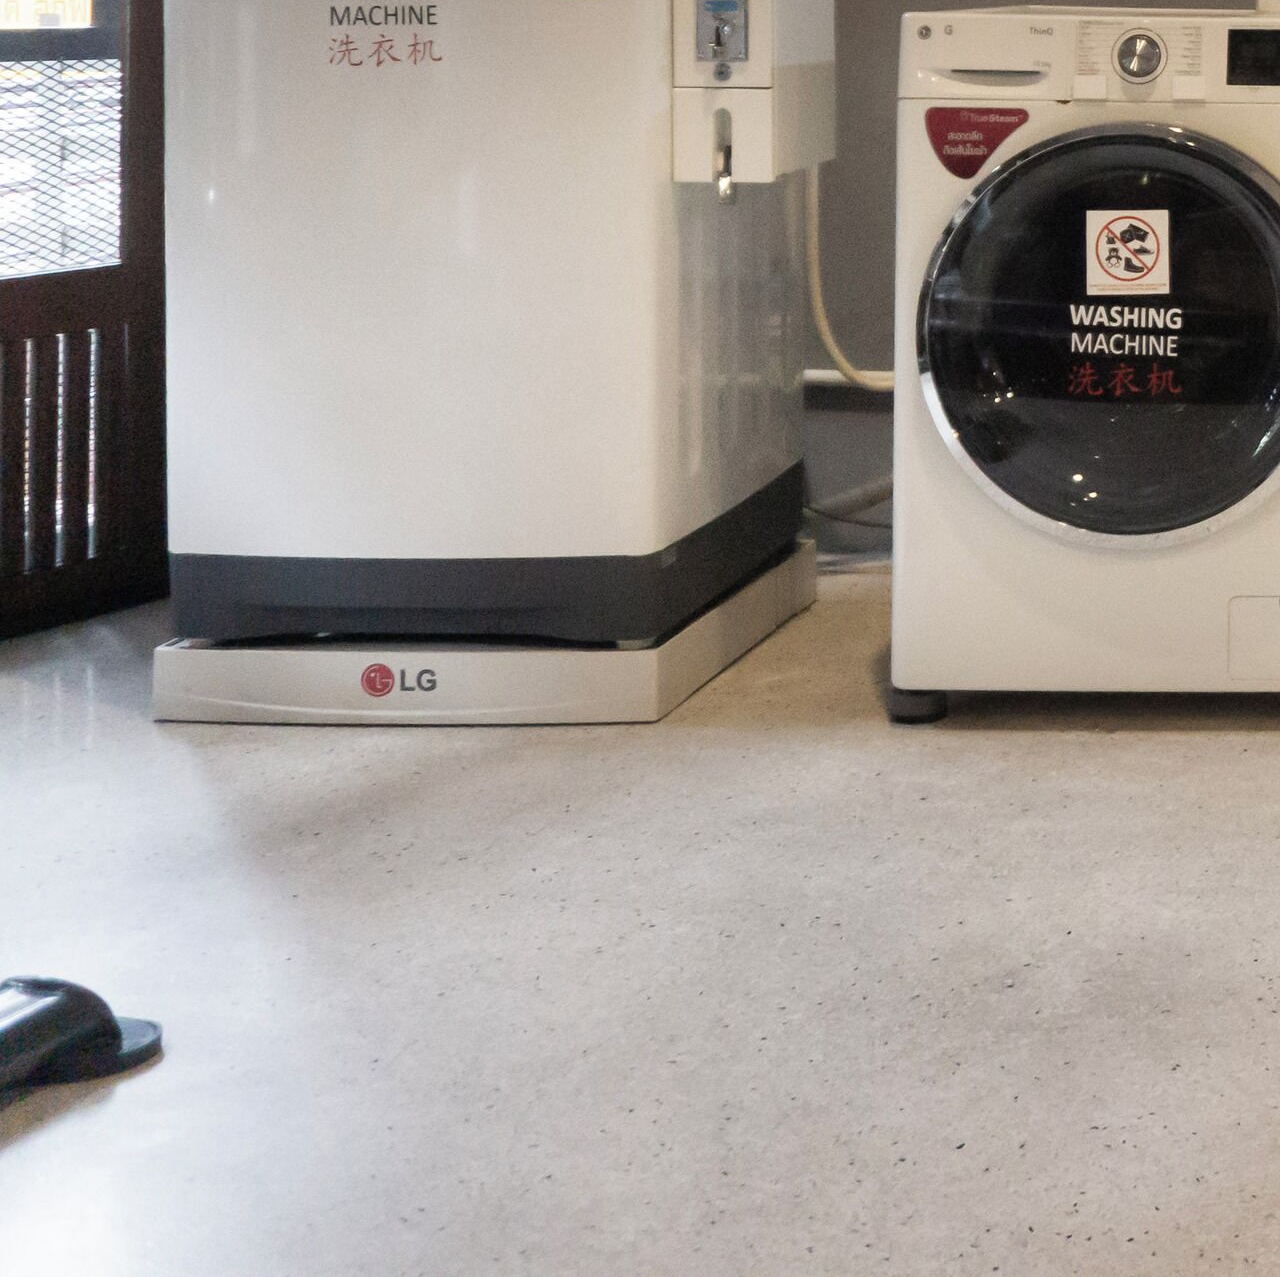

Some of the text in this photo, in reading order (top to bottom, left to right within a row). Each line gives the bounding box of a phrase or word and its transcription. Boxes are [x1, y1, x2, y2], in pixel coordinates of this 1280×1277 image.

[330, 5, 438, 26] MACHINE
[1029, 26, 1054, 36] ThinQ
[329, 32, 442, 68] 洗衣机
[1069, 304, 1182, 330] WASHING
[1071, 332, 1179, 357] MACHINE
[1067, 362, 1182, 397] 洗衣机
[400, 668, 437, 692] LG
